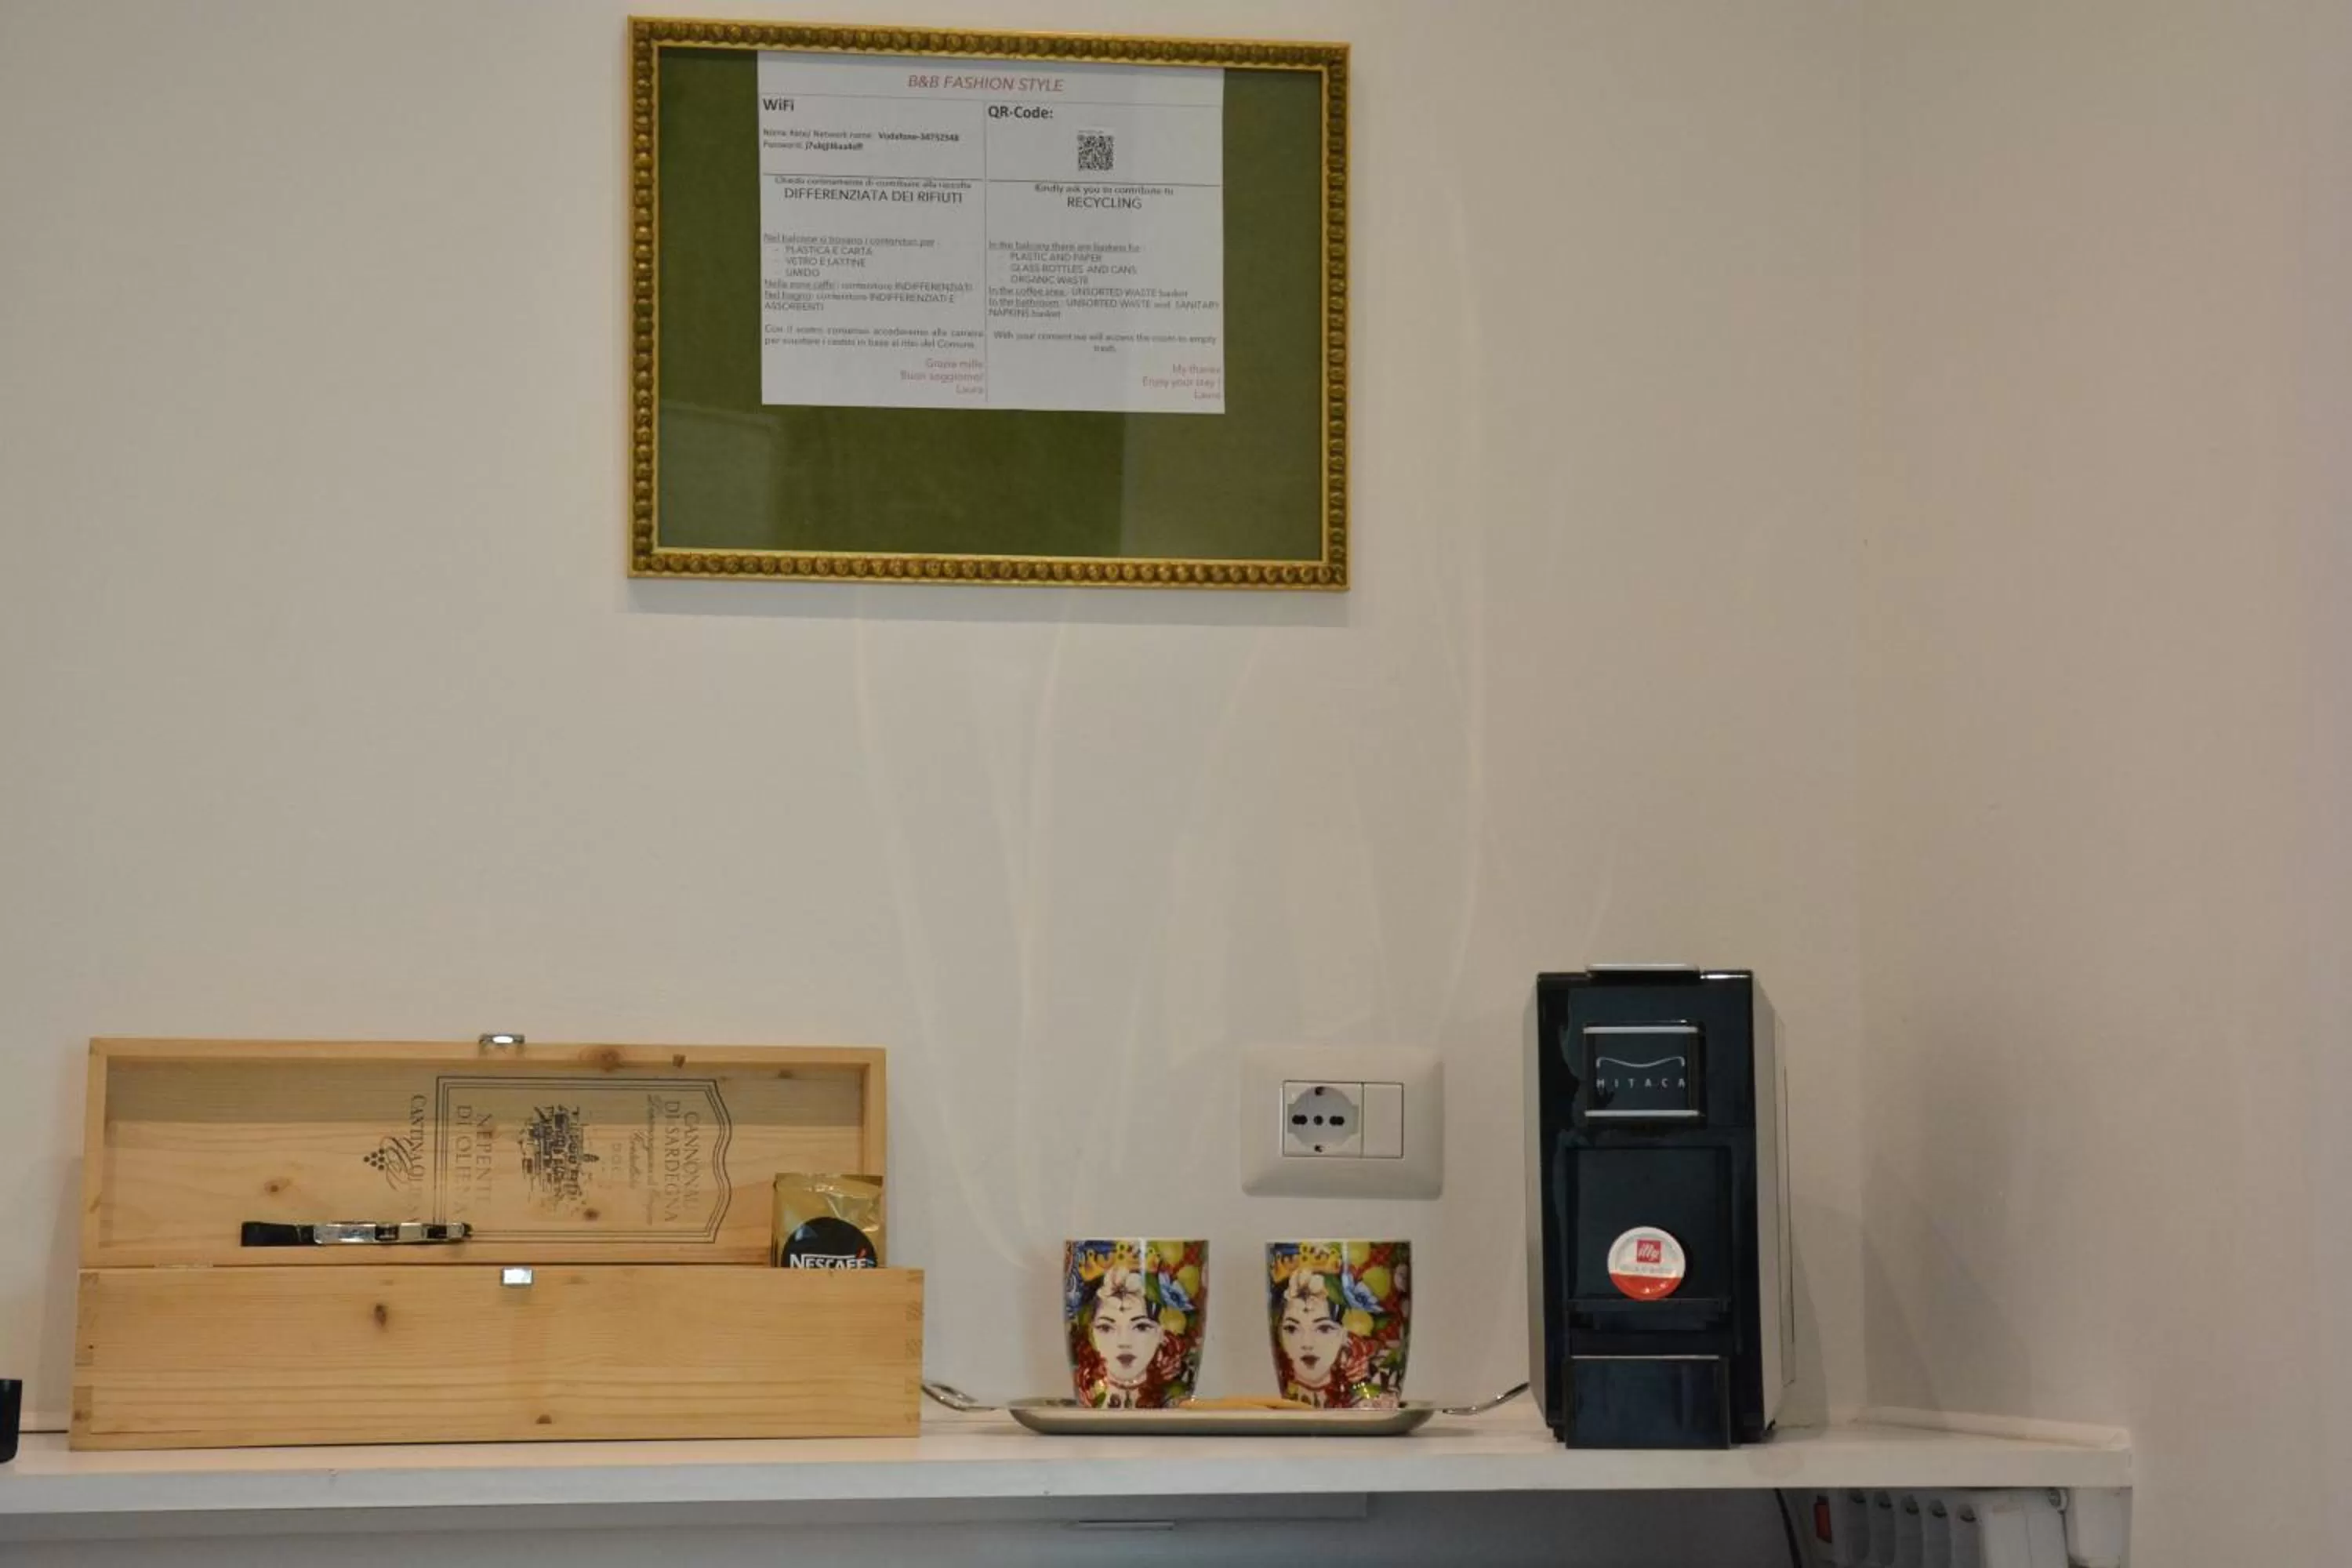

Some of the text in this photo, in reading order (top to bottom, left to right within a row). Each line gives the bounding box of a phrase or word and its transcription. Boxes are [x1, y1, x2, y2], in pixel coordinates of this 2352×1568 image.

[907, 74, 1065, 93] B&B FASHION STYLE
[762, 97, 795, 112] WiFi
[987, 105, 1054, 119] QR-Code:
[783, 187, 963, 204] DIFFERENZIATA DEI RIFIUTI
[1083, 186, 1101, 195] you
[1067, 196, 1143, 210] RECYCLING
[786, 245, 831, 255] PLASTICA
[840, 246, 873, 256] CARTA
[1009, 252, 1048, 261] PLASTIC
[1049, 252, 1072, 261] AND
[1087, 264, 1109, 274] AND
[1595, 1077, 1686, 1089] MITACA
[454, 1105, 474, 1215] DI OLIENA
[476, 1112, 494, 1205] NEPENTE
[663, 1099, 681, 1223] DI SARDEGNA
[683, 1110, 701, 1210] CANNONAU
[1638, 1243, 1660, 1261] illy
